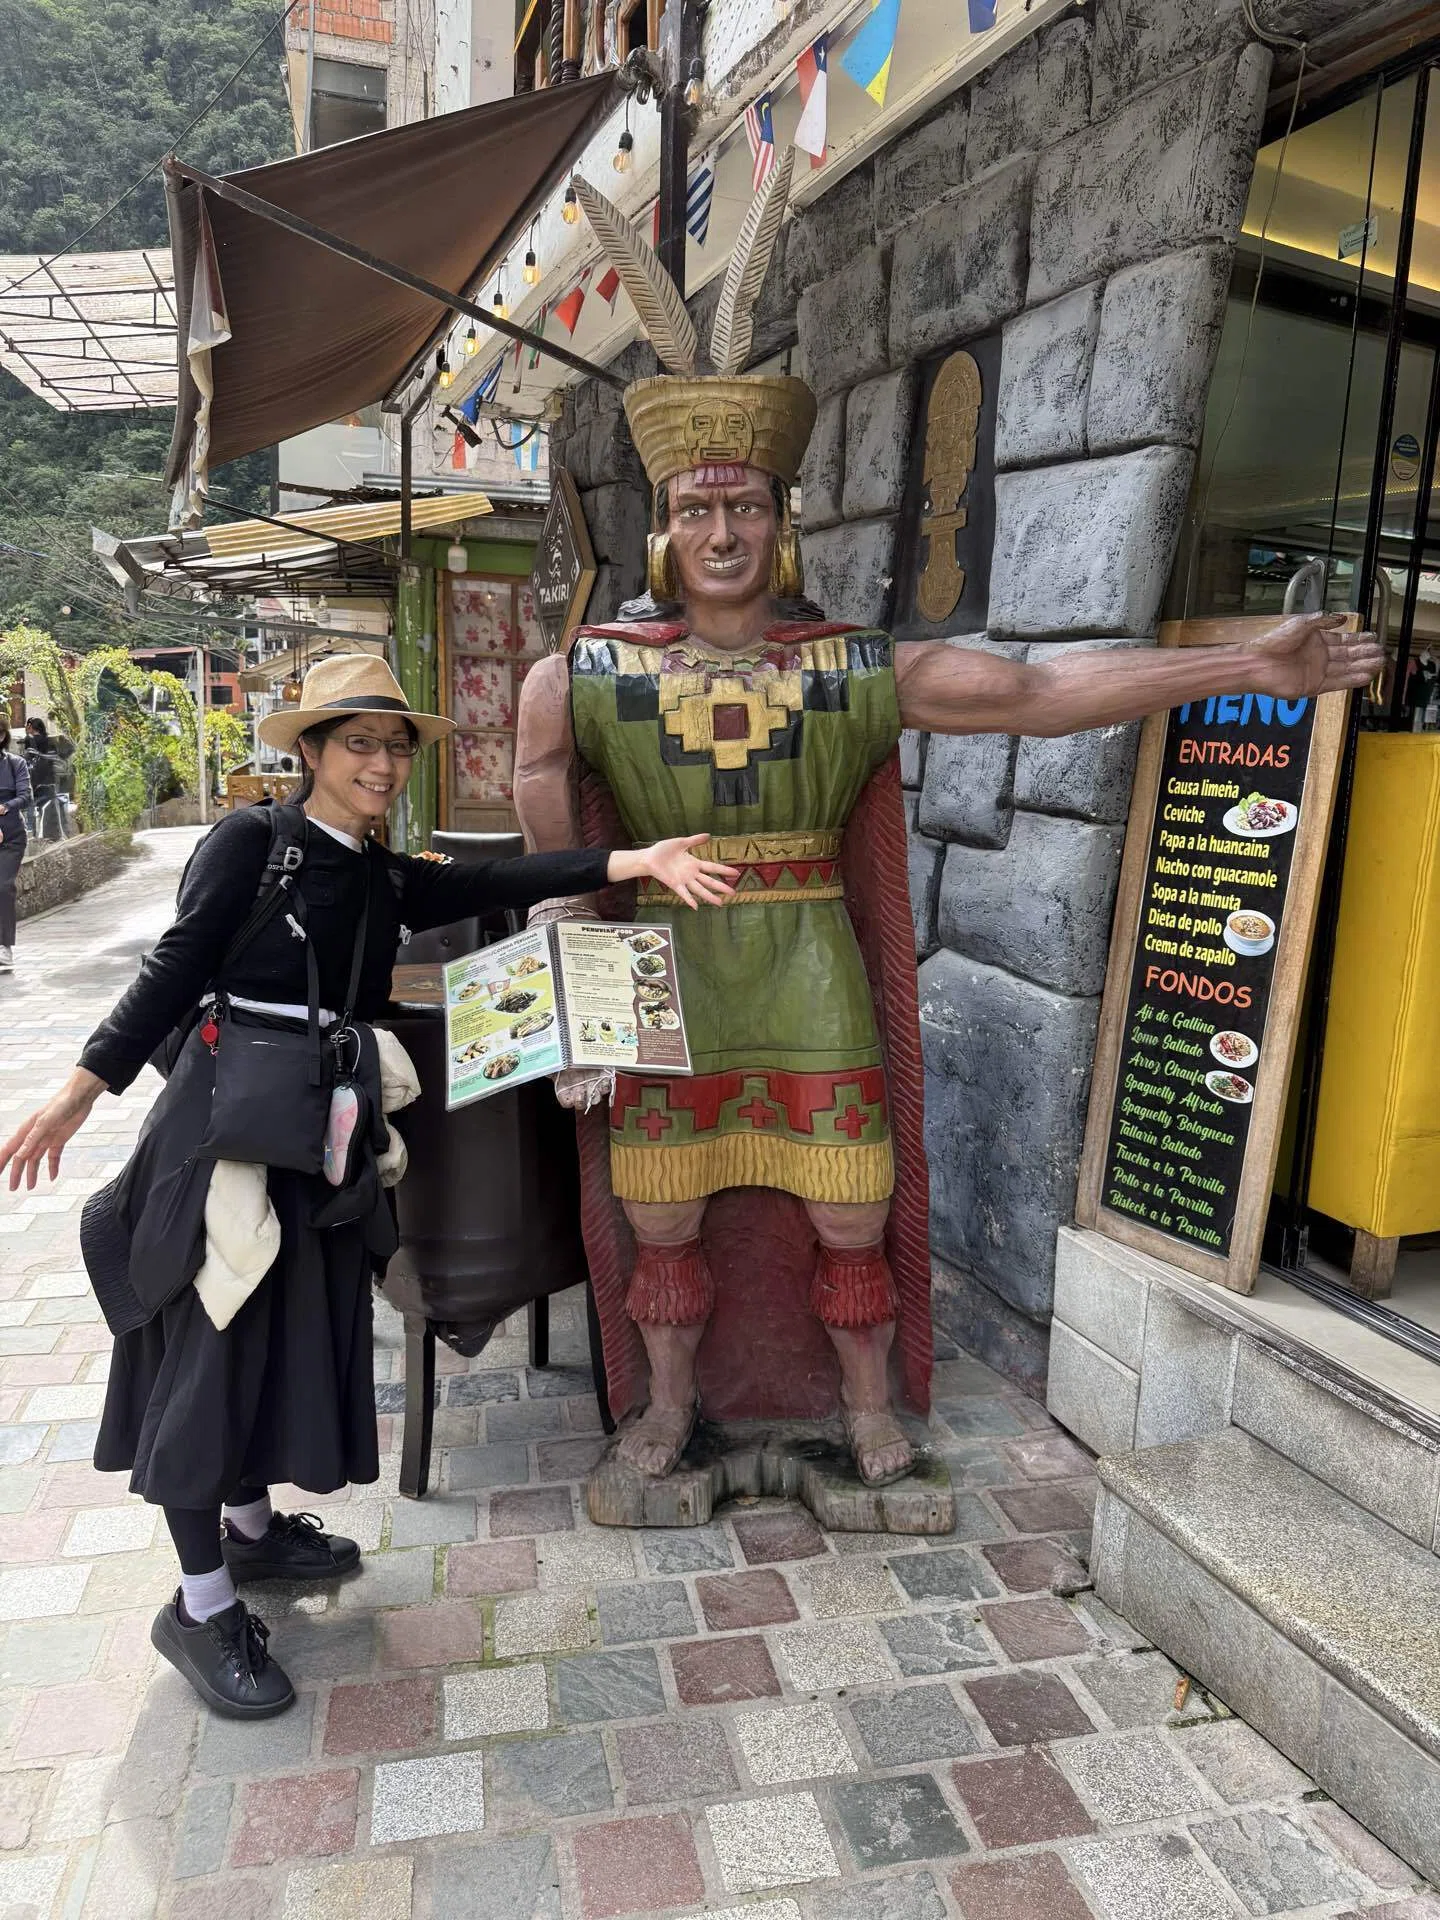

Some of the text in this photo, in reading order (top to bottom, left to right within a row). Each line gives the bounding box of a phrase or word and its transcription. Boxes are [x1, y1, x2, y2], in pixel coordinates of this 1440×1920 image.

[540, 583, 570, 603] TAKIRI
[1179, 739, 1291, 768] ENTRADAS
[1167, 777, 1240, 799] Causa limeña
[1163, 803, 1206, 824] Ceviche
[1159, 830, 1271, 858] Papa a la huancaina
[1155, 856, 1278, 888] Nacho con guacamole
[1151, 882, 1242, 911] Sopa a la minuta
[1148, 907, 1223, 937] Dieta de pollo
[1144, 933, 1237, 967] Crema de zapallo
[1145, 965, 1253, 1009] FONDOS
[1131, 1026, 1159, 1045] Lomo
[1155, 1009, 1169, 1023] de
[1172, 1011, 1217, 1035] Gallina
[1128, 1051, 1206, 1087] Arroz Chaufa
[1179, 1091, 1224, 1116] Alfredo
[1119, 1119, 1158, 1146] Tallarin
[1176, 1113, 1235, 1146] Bolognesa
[1115, 1142, 1226, 1195] Trucha a la Parrilla
[1112, 1166, 1215, 1217] Pollo a la Parrilla
[1149, 1210, 1158, 1220] a
[1160, 1212, 1172, 1226] la
[1176, 1215, 1222, 1246] Parrilla
